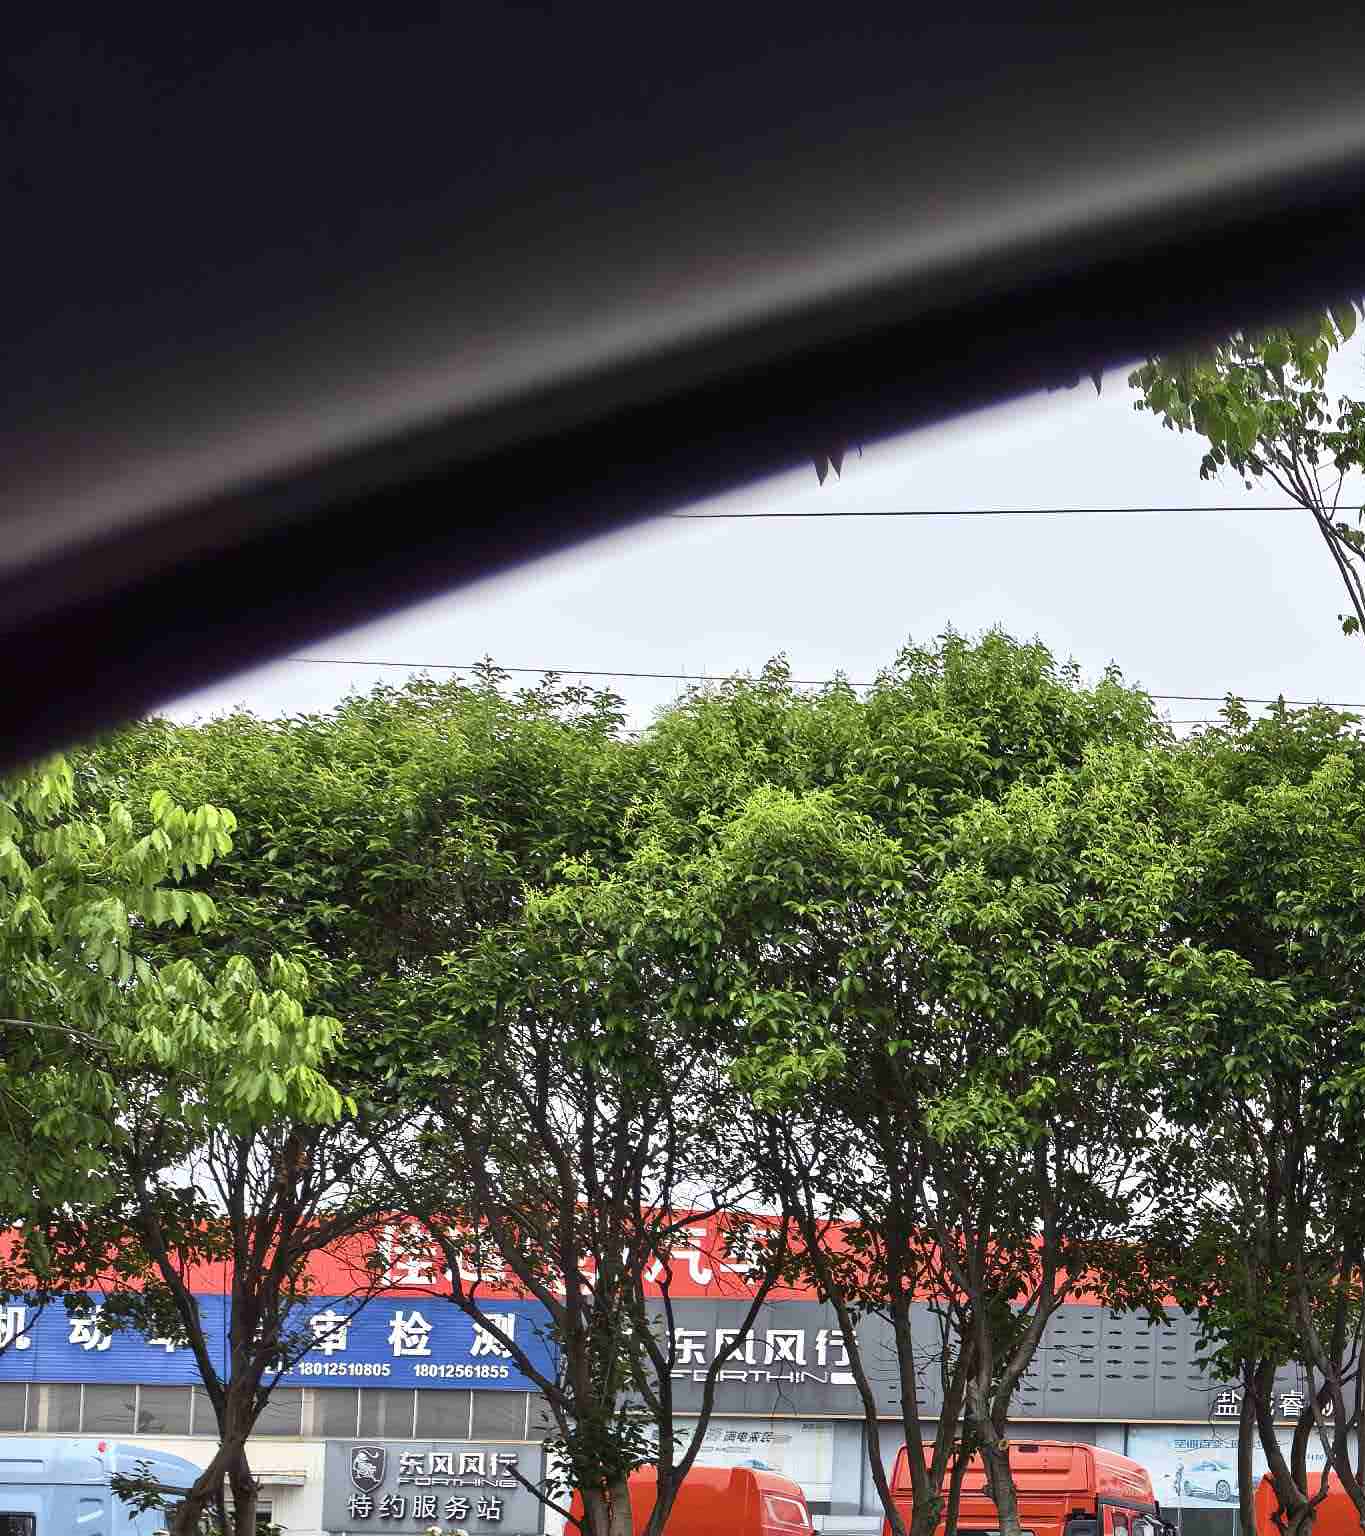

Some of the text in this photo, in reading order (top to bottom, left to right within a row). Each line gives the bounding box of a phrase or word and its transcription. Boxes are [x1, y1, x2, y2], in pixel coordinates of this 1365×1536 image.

[664, 1327, 860, 1366] 东风风行
[299, 1361, 391, 1377] 18012510805
[413, 1363, 509, 1379] 18012561855
[399, 1451, 519, 1476] 东风风行
[398, 1476, 520, 1488] FORTHING
[347, 1494, 503, 1521] 特约服务站
